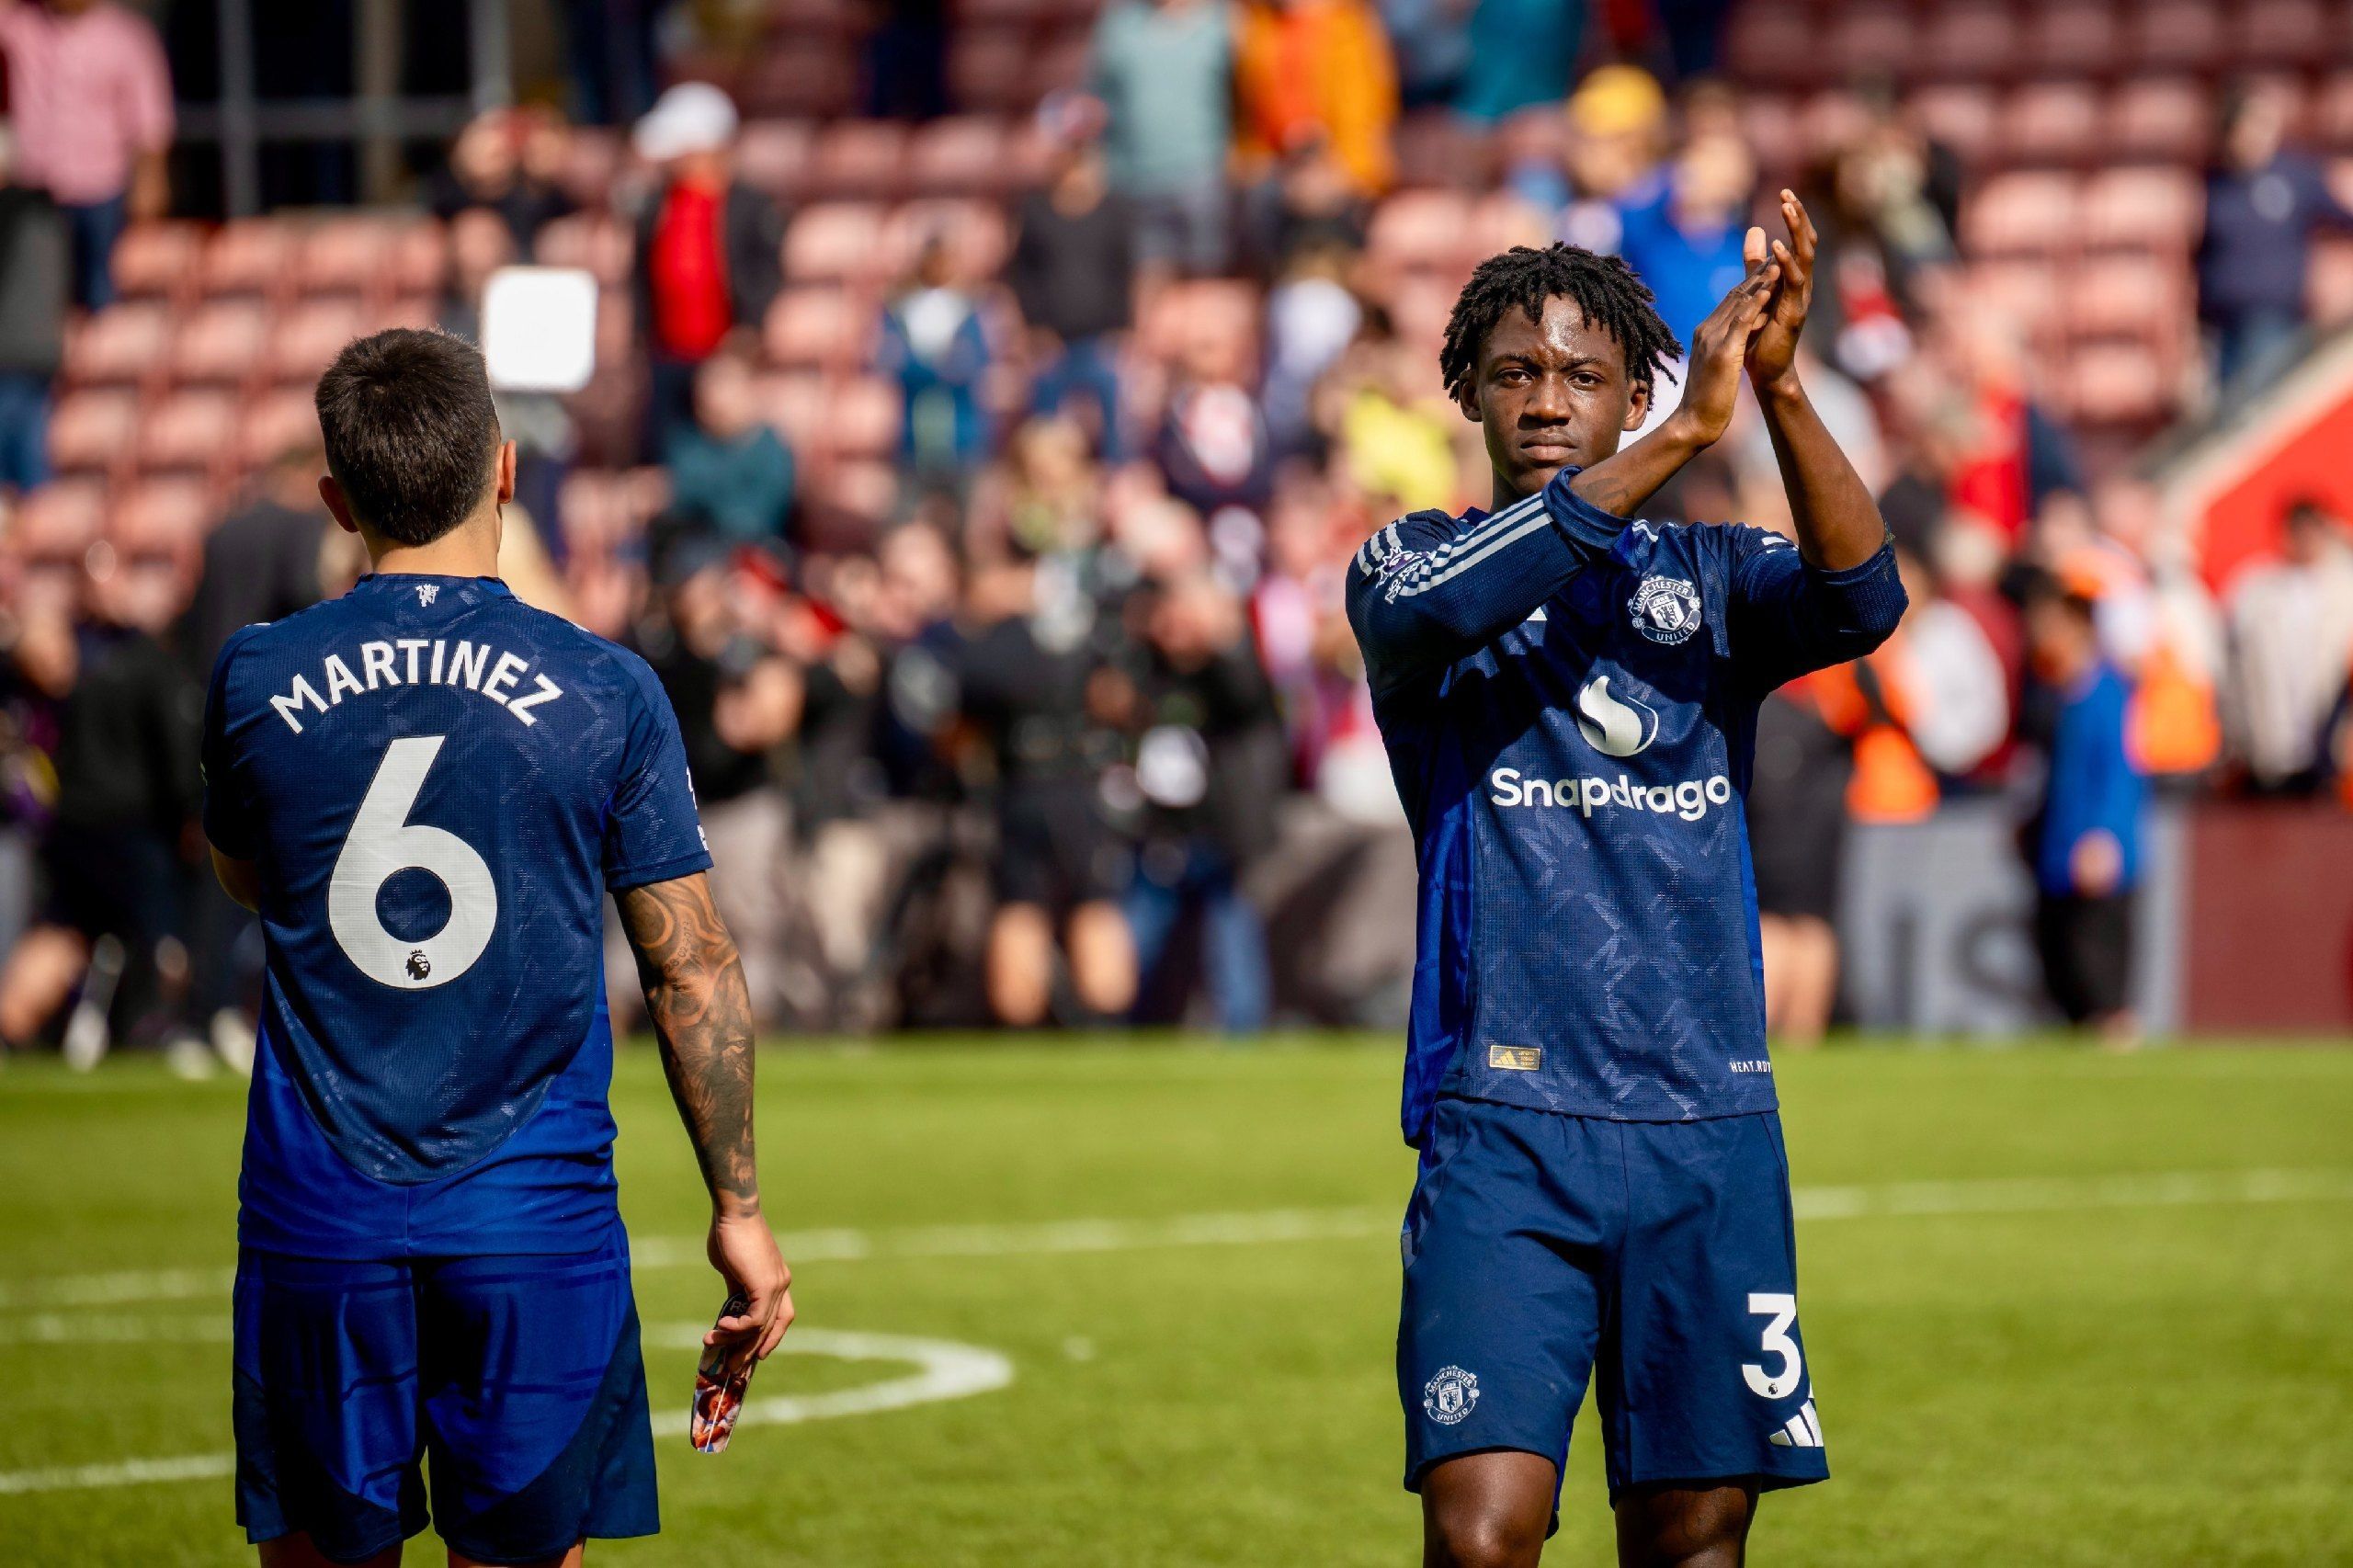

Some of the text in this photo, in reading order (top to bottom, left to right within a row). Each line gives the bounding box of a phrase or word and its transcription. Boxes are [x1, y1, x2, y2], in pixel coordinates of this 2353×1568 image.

[1633, 582, 1688, 611] MANCHESTER
[1656, 622, 1695, 641] UNITED
[269, 639, 563, 734] MARTINEZ
[1492, 768, 1730, 821] Snapdrago
[328, 735, 497, 990] 6
[1743, 1293, 1813, 1399] 3
[1428, 1370, 1472, 1392] MANCHESTER
[1438, 1408, 1468, 1421] UNITED
